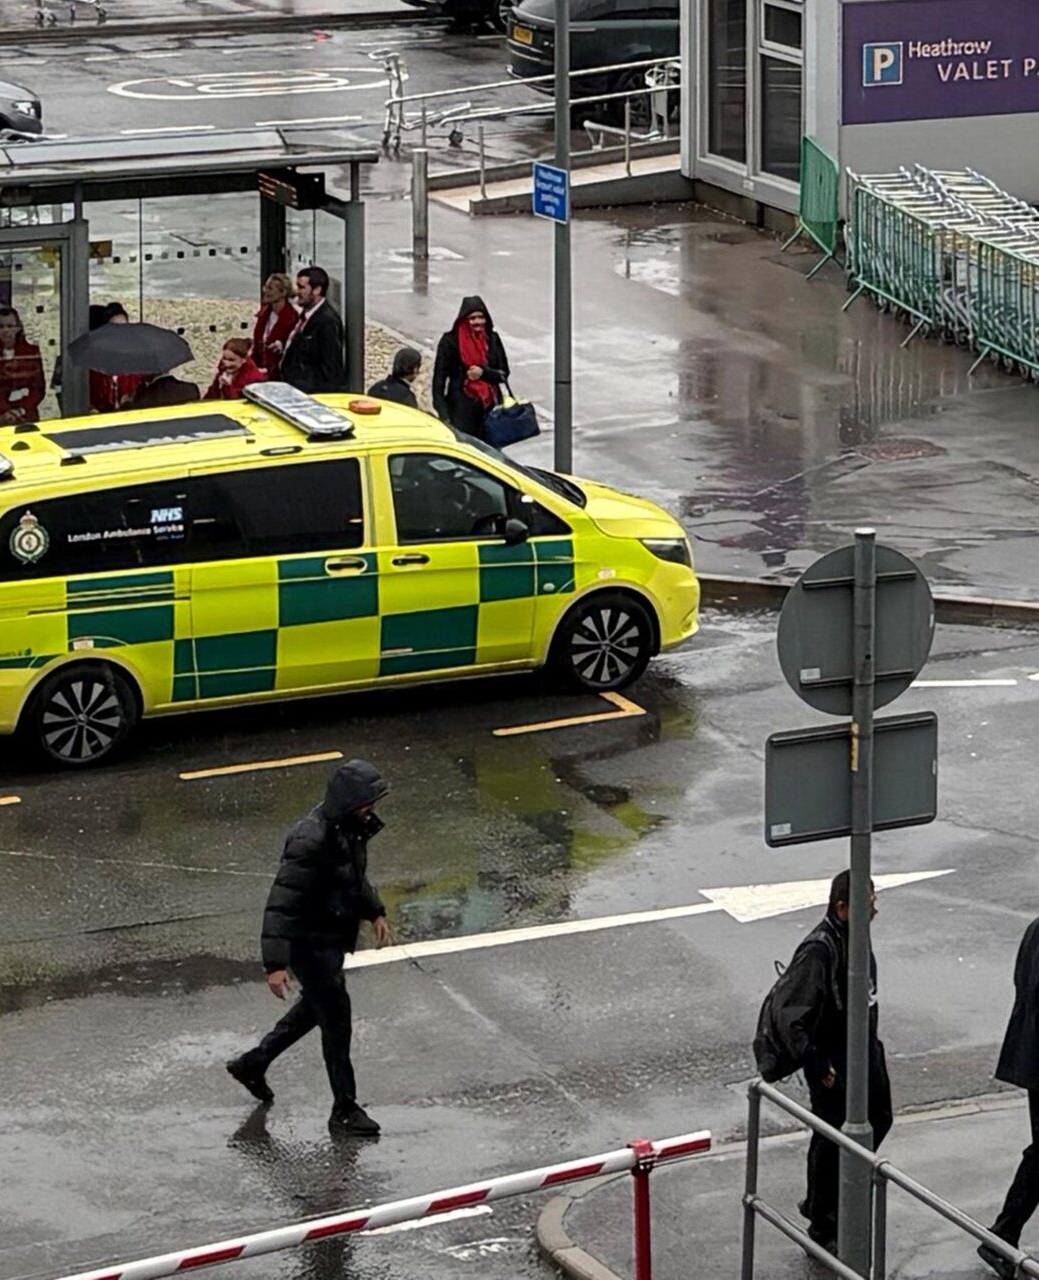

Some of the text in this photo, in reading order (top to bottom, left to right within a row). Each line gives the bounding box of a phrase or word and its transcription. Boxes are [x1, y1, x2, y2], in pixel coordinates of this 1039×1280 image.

[908, 38, 992, 59] Heathrow
[873, 47, 895, 82] P
[937, 58, 1039, 83] VALET P
[150, 507, 183, 523] NHS
[67, 532, 102, 543] London
[103, 528, 152, 539] Ambulance
[152, 523, 185, 534] Service
